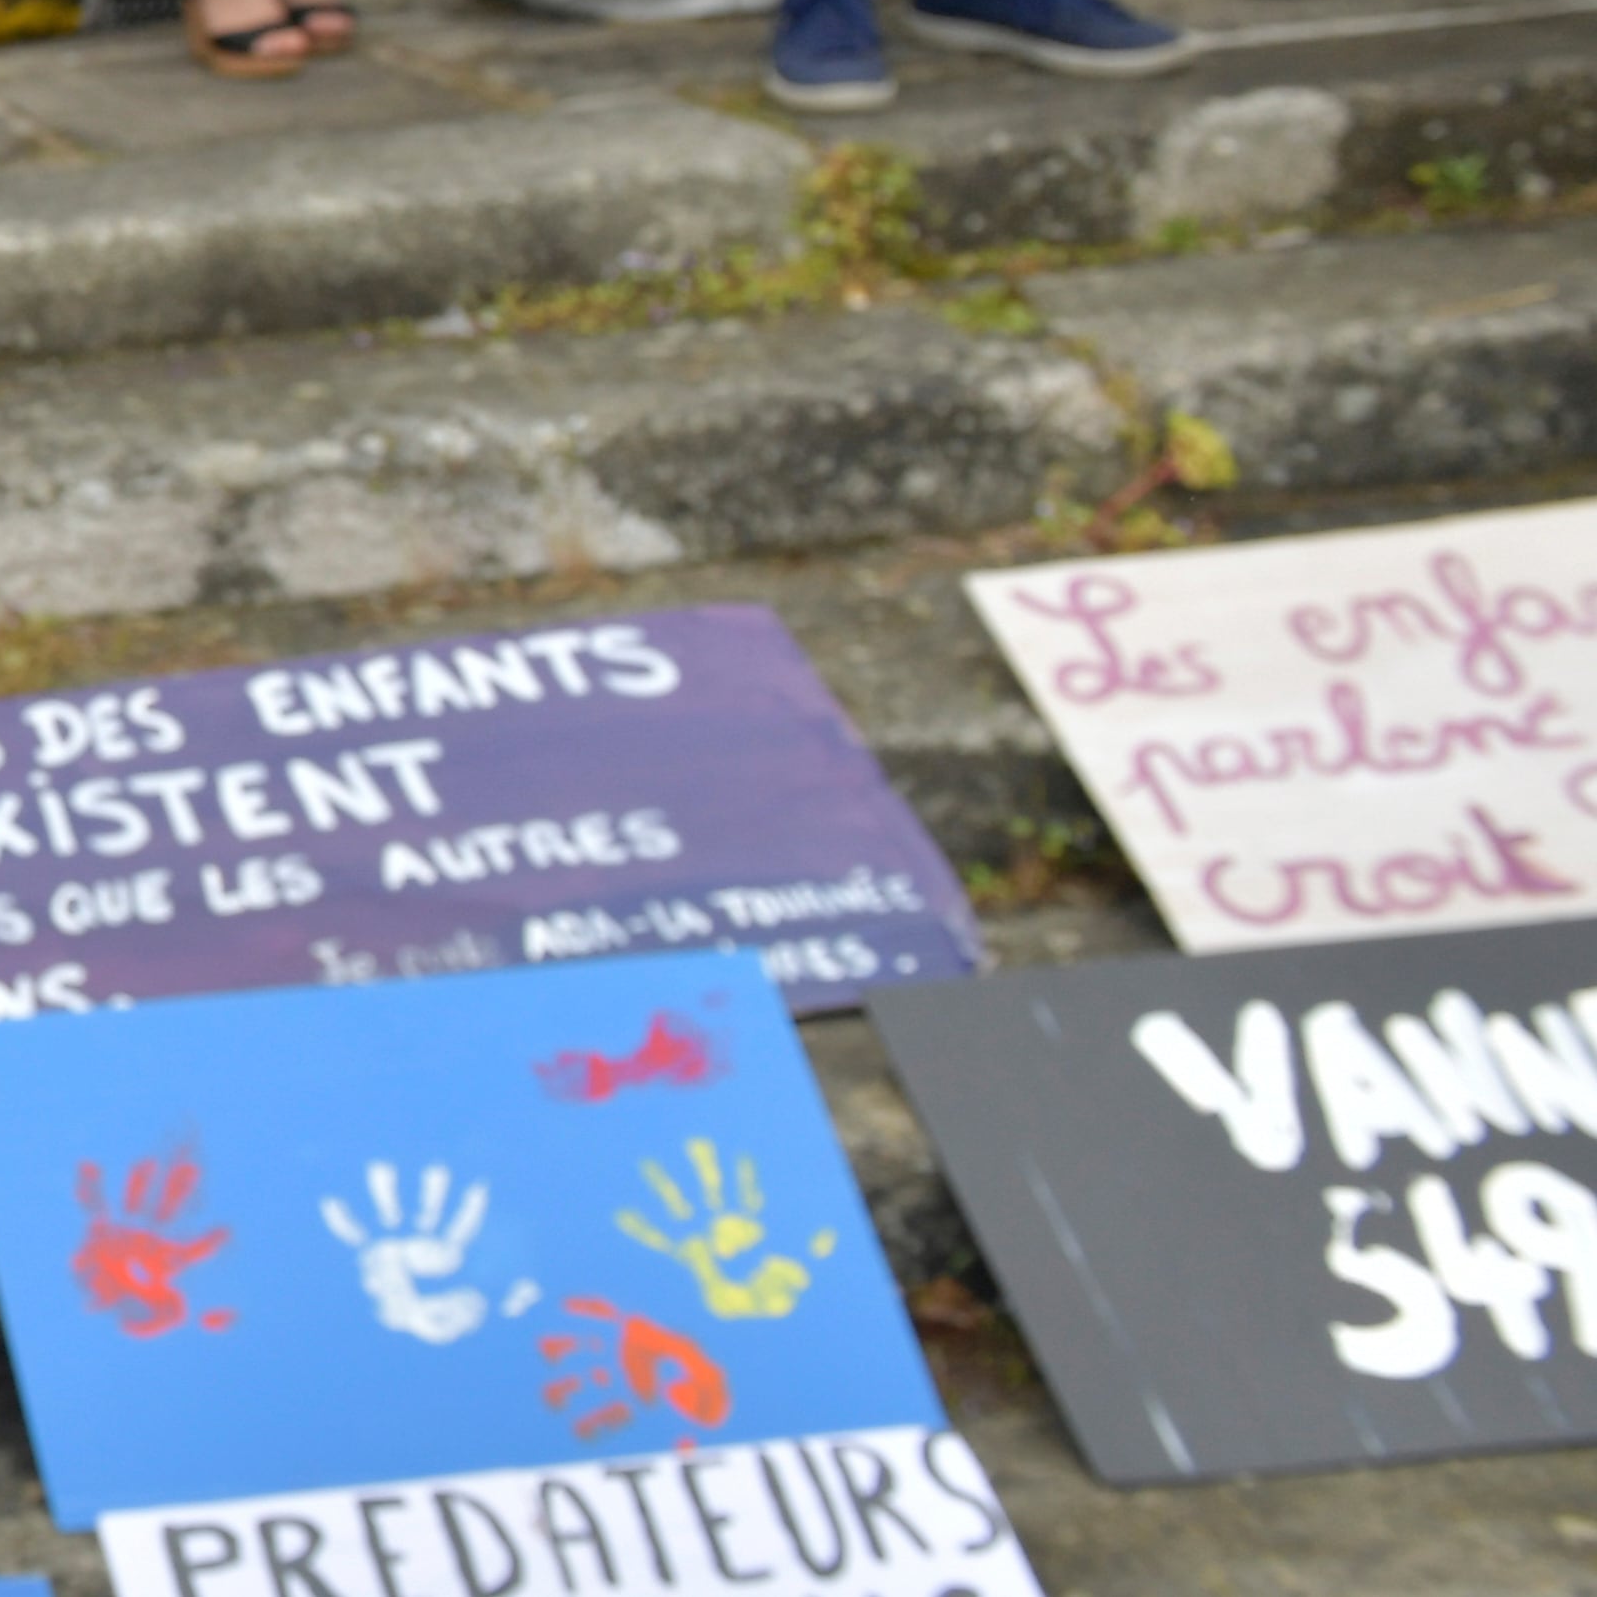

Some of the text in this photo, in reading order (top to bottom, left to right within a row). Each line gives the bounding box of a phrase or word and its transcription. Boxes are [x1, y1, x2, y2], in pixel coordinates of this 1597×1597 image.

[21, 686, 187, 763] DES
[244, 623, 684, 737] ENFANTS
[1009, 573, 1223, 706] Les
[47, 868, 175, 936] QUE
[200, 851, 326, 917] LES
[379, 807, 684, 893] AUTRES
[1129, 987, 1597, 1173] VANN
[161, 1427, 1010, 1597] PREDATEURS
